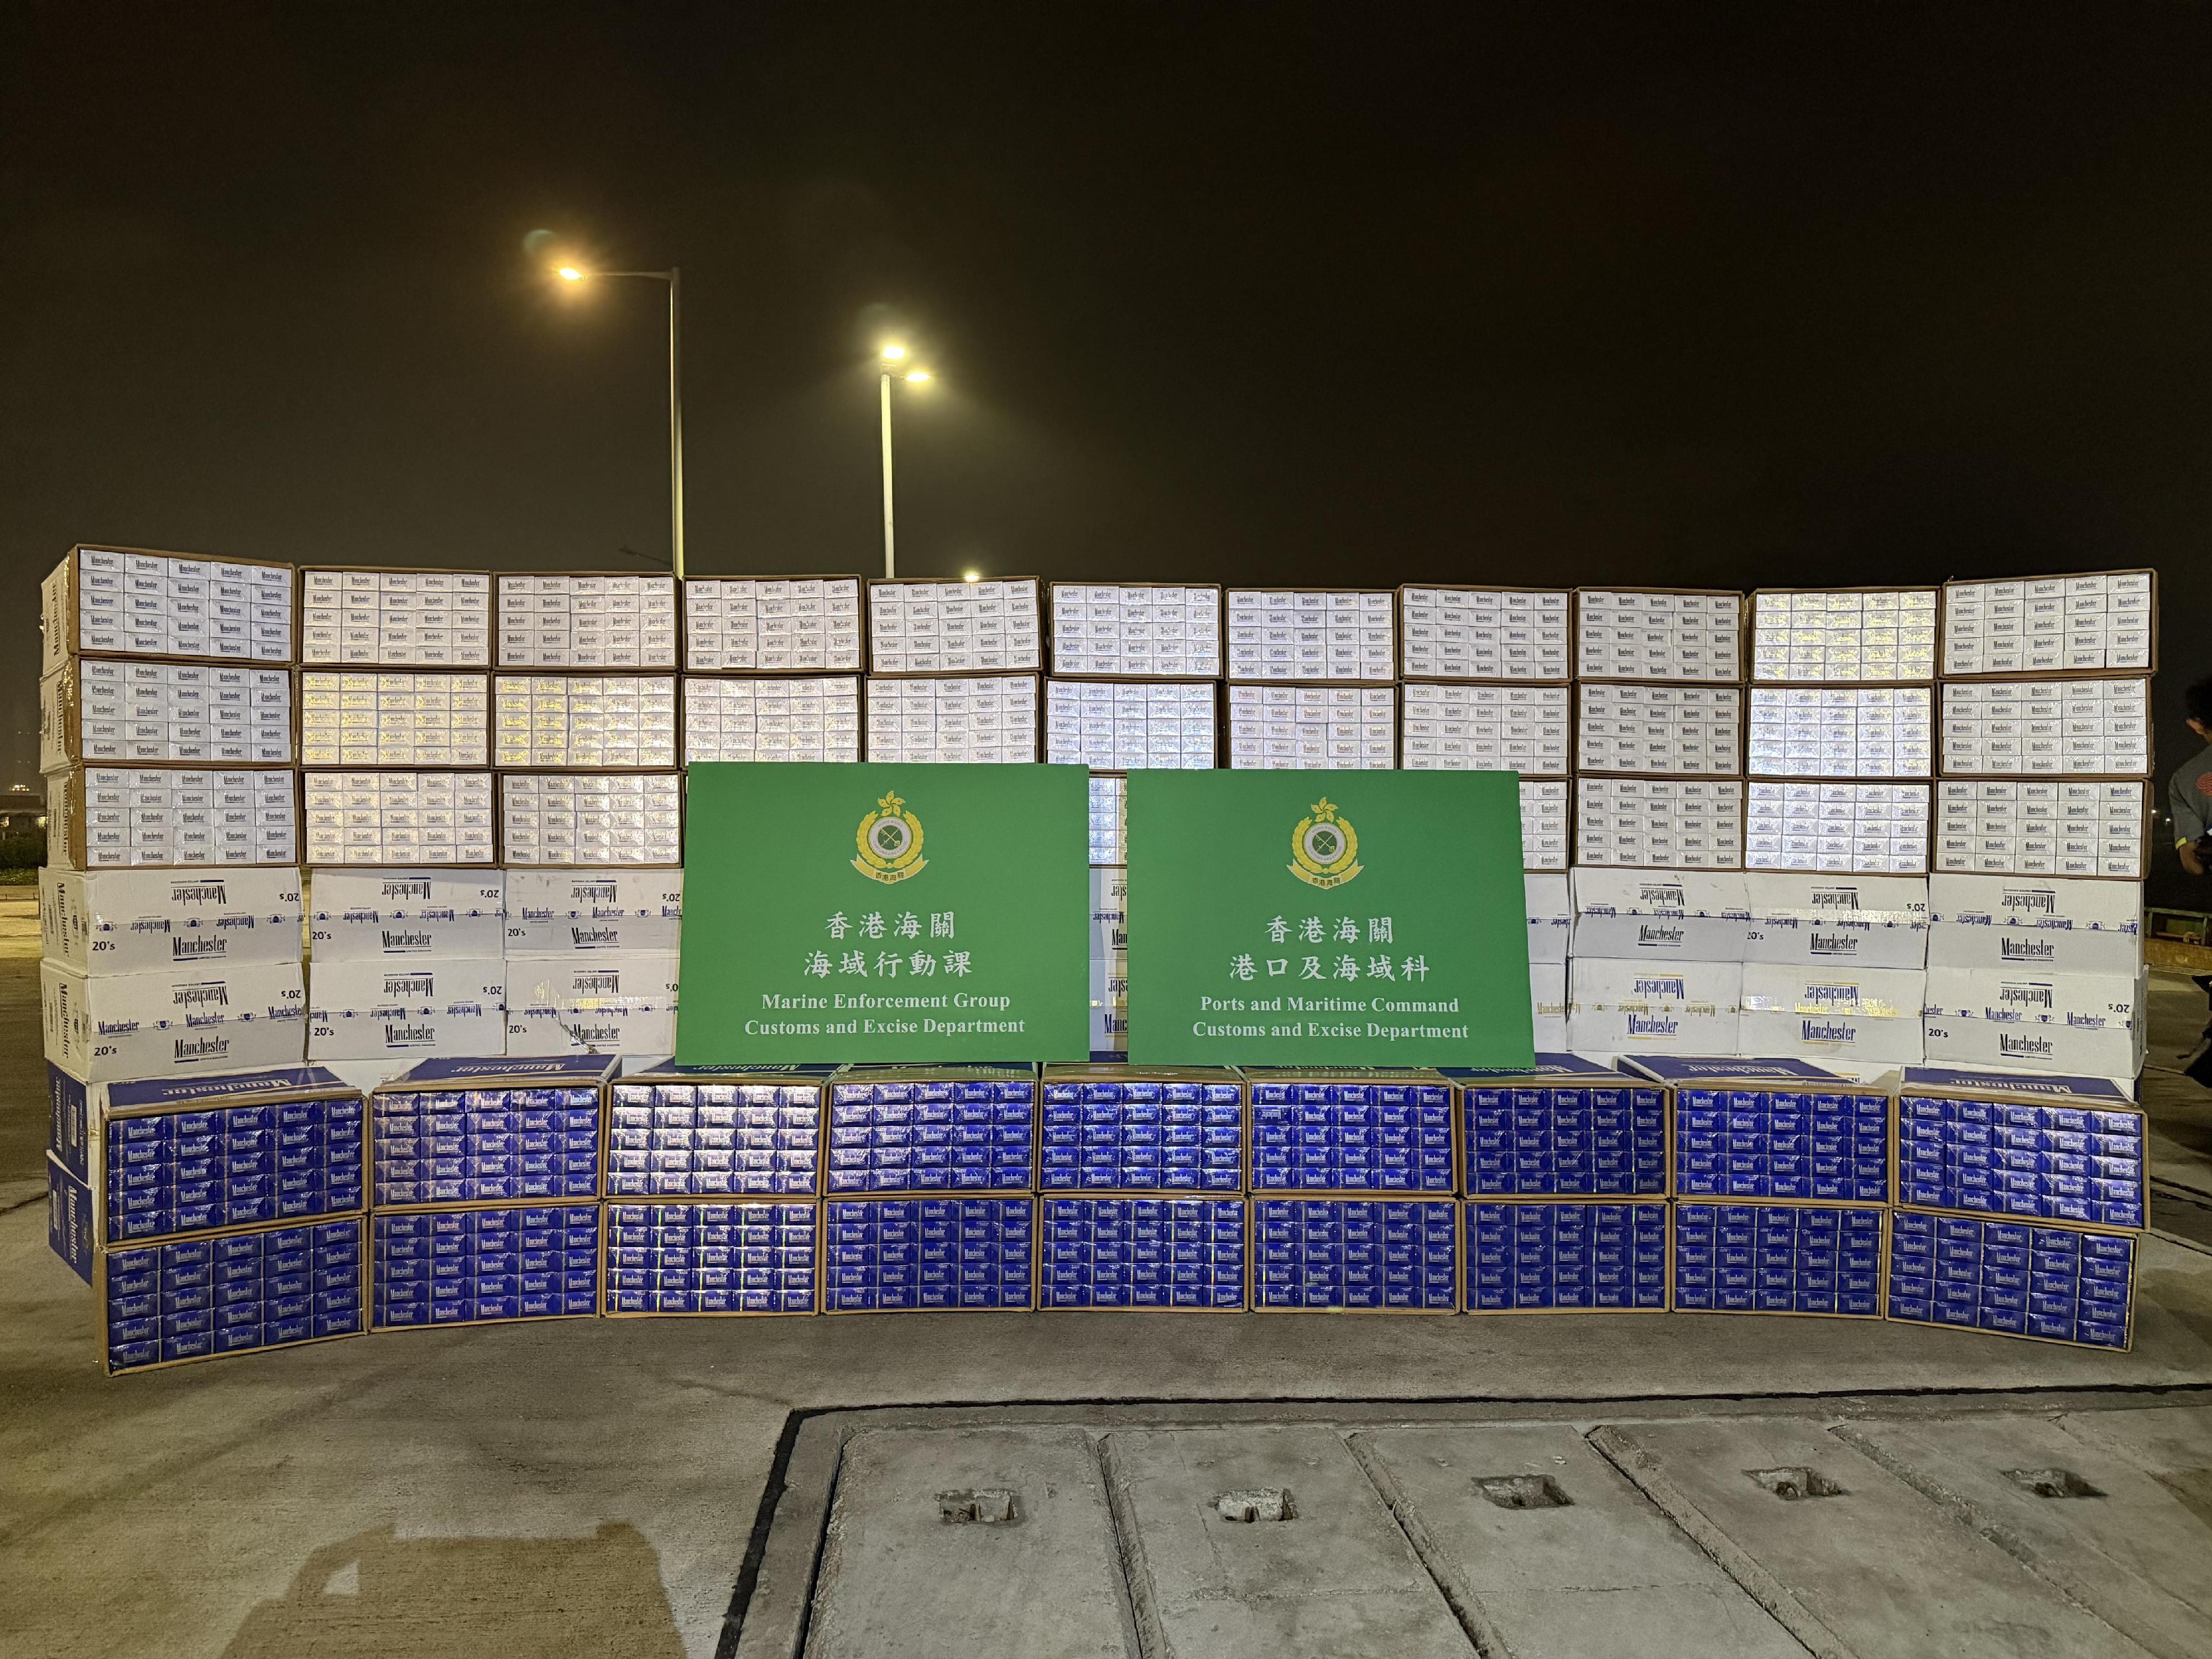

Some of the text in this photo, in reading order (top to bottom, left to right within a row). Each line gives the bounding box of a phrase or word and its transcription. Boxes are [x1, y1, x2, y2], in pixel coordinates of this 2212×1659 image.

[171, 885, 227, 906] Manchester
[279, 893, 300, 902] 20's
[382, 881, 431, 900] Manchester
[480, 890, 499, 898] 20's
[571, 885, 617, 903] Manchester
[662, 893, 681, 902] 20's
[1639, 888, 1685, 906] Manchester
[1812, 892, 1859, 910] Manchester
[1907, 903, 1926, 912] 20's
[2001, 894, 2055, 914] Manchester
[343, 910, 379, 923] Manchester
[419, 910, 455, 922] Manchester
[522, 907, 555, 920] Manchester
[592, 906, 625, 918] Manchester
[1093, 911, 1124, 924] Manchester
[1653, 909, 1684, 920] Manchester
[131, 919, 171, 933] Manchester
[216, 915, 254, 930] Manchester
[825, 911, 955, 940] 香港海關
[1764, 917, 1798, 929] Manchester
[1956, 915, 1992, 926] Manchester
[312, 931, 332, 940] 20's
[507, 928, 526, 937] 20's
[571, 926, 618, 945] Manchester
[1265, 915, 1393, 944] 香港海關
[1638, 925, 1684, 941] Manchester
[92, 941, 116, 951] 20's
[173, 935, 227, 956] Manchester
[382, 930, 432, 948] Manchester
[1810, 933, 1858, 951] Manchester
[2001, 937, 2055, 956] Manchester
[804, 950, 972, 979] 海域行動課
[1229, 953, 1430, 982] 港口及海域科
[384, 978, 434, 998] Manchester
[483, 986, 503, 995] 20's
[572, 975, 619, 994] Manchester
[665, 983, 679, 992] 0's
[1634, 978, 1684, 999] Manchester
[173, 986, 229, 1008] Manchester
[281, 990, 301, 999] 20's
[762, 993, 1010, 1012] Marine Enforcement Group
[1804, 986, 1859, 1006] Manchester
[2000, 988, 2053, 1009] Manchester
[447, 1004, 482, 1018] Manchester
[1201, 997, 1459, 1013] Ports and Maritime Command
[1537, 1002, 1565, 1015] Mancheste
[1618, 1003, 1649, 1016] Manchester
[1684, 1004, 1716, 1017] Manchester
[2108, 1004, 2130, 1013] 20's
[186, 1011, 224, 1027] Manchester
[370, 1007, 406, 1020] Manchester
[1985, 1006, 2022, 1021] Manchester
[2067, 1011, 2106, 1027] Manchester
[98, 1019, 139, 1035] Manchester
[314, 1027, 335, 1036] 20's
[508, 1025, 527, 1034] 20's
[573, 1024, 620, 1041] Manchester
[745, 1019, 1025, 1037] Customs and Excise Department
[1193, 1021, 1469, 1041] Customs and Excise Department
[1627, 1014, 1678, 1035] Manchester
[1801, 1020, 1856, 1041] Manchester
[385, 1024, 435, 1043] Manchester
[1928, 1028, 1949, 1039] 20's
[94, 1046, 117, 1056] 20's
[174, 1036, 229, 1058] Manchester
[2000, 1033, 2053, 1053] Manchester
[1951, 1078, 2073, 1095] Manchester
